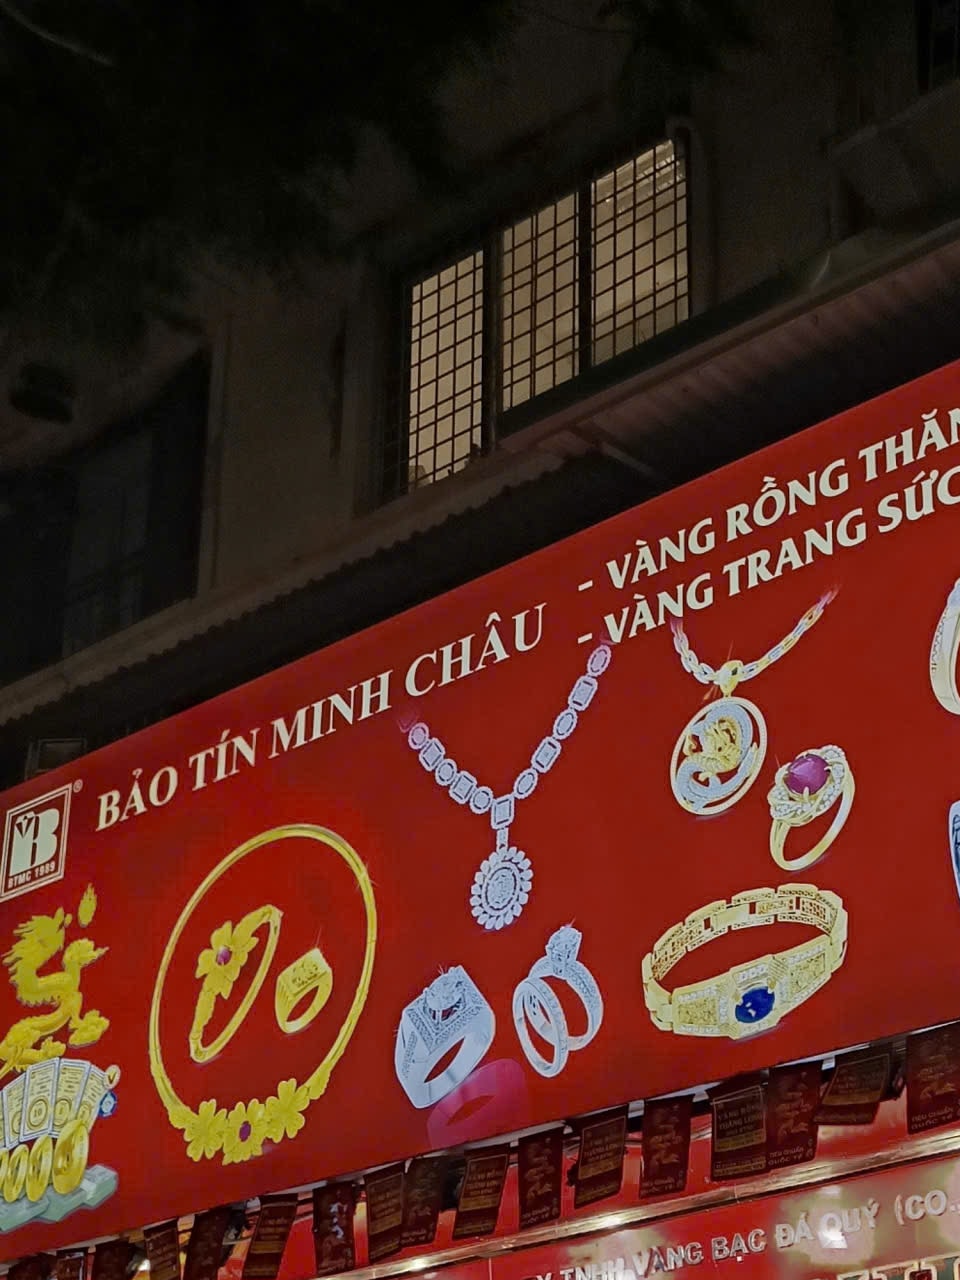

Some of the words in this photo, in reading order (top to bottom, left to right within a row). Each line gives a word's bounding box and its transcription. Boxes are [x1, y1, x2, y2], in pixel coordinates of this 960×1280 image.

[604, 573, 713, 644] VÀNG
[722, 509, 867, 597] TRANG
[606, 517, 715, 590] VÀNG
[726, 459, 849, 542] RỒNG
[96, 766, 178, 831] BẢO
[188, 729, 259, 791] TÍN
[268, 670, 395, 758] MINH
[403, 603, 547, 697] CHÂU
[8, 872, 32, 889] BTMC
[711, 1229, 765, 1263] BẠC
[774, 1211, 814, 1248] ĐÁ
